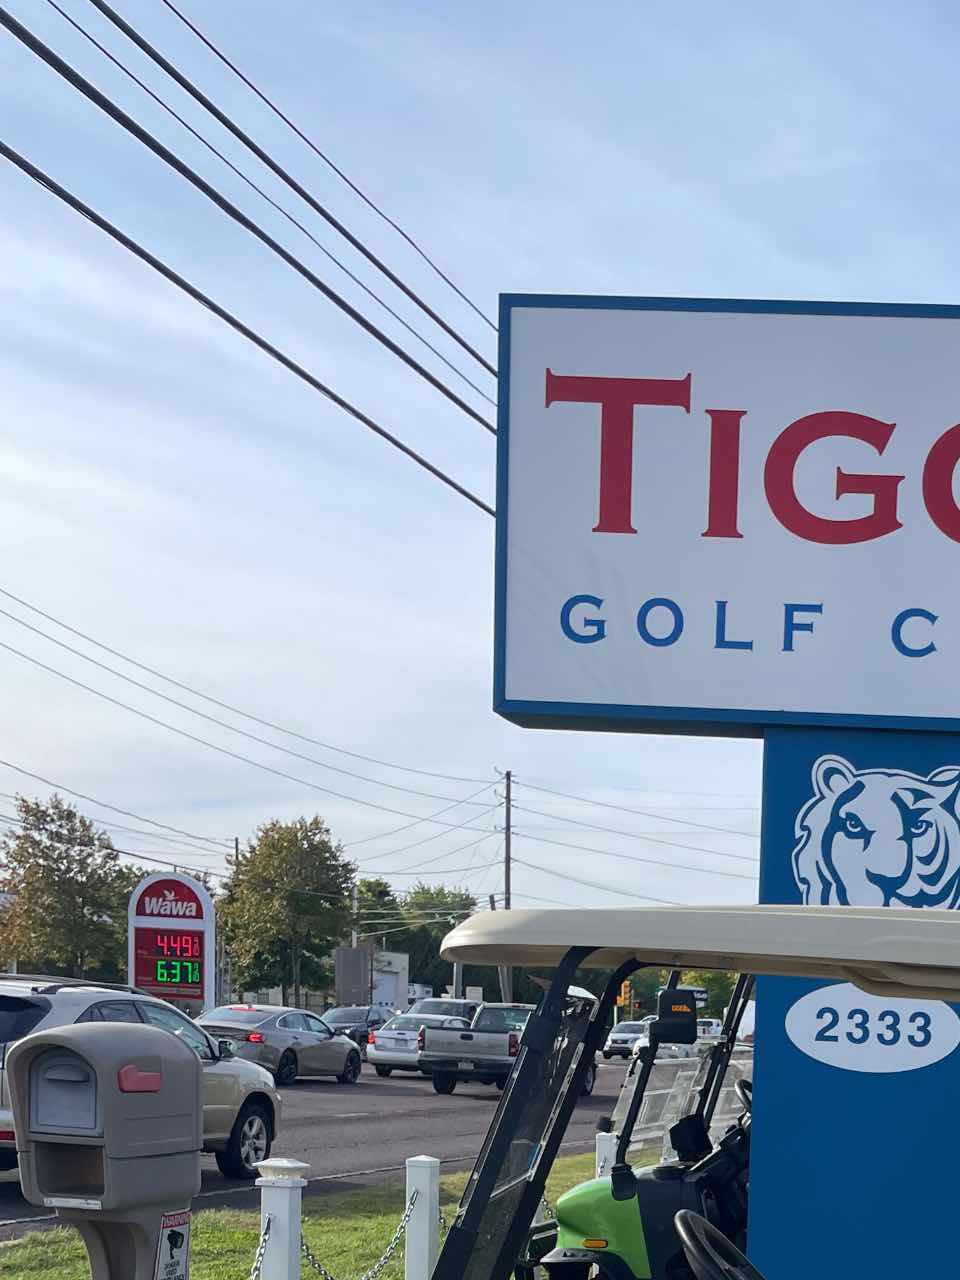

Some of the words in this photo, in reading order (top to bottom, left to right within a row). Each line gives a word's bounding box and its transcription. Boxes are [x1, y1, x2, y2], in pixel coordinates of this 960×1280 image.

[559, 594, 824, 652] GOLF
[144, 896, 197, 917] Wawa
[814, 1006, 932, 1048] 2333
